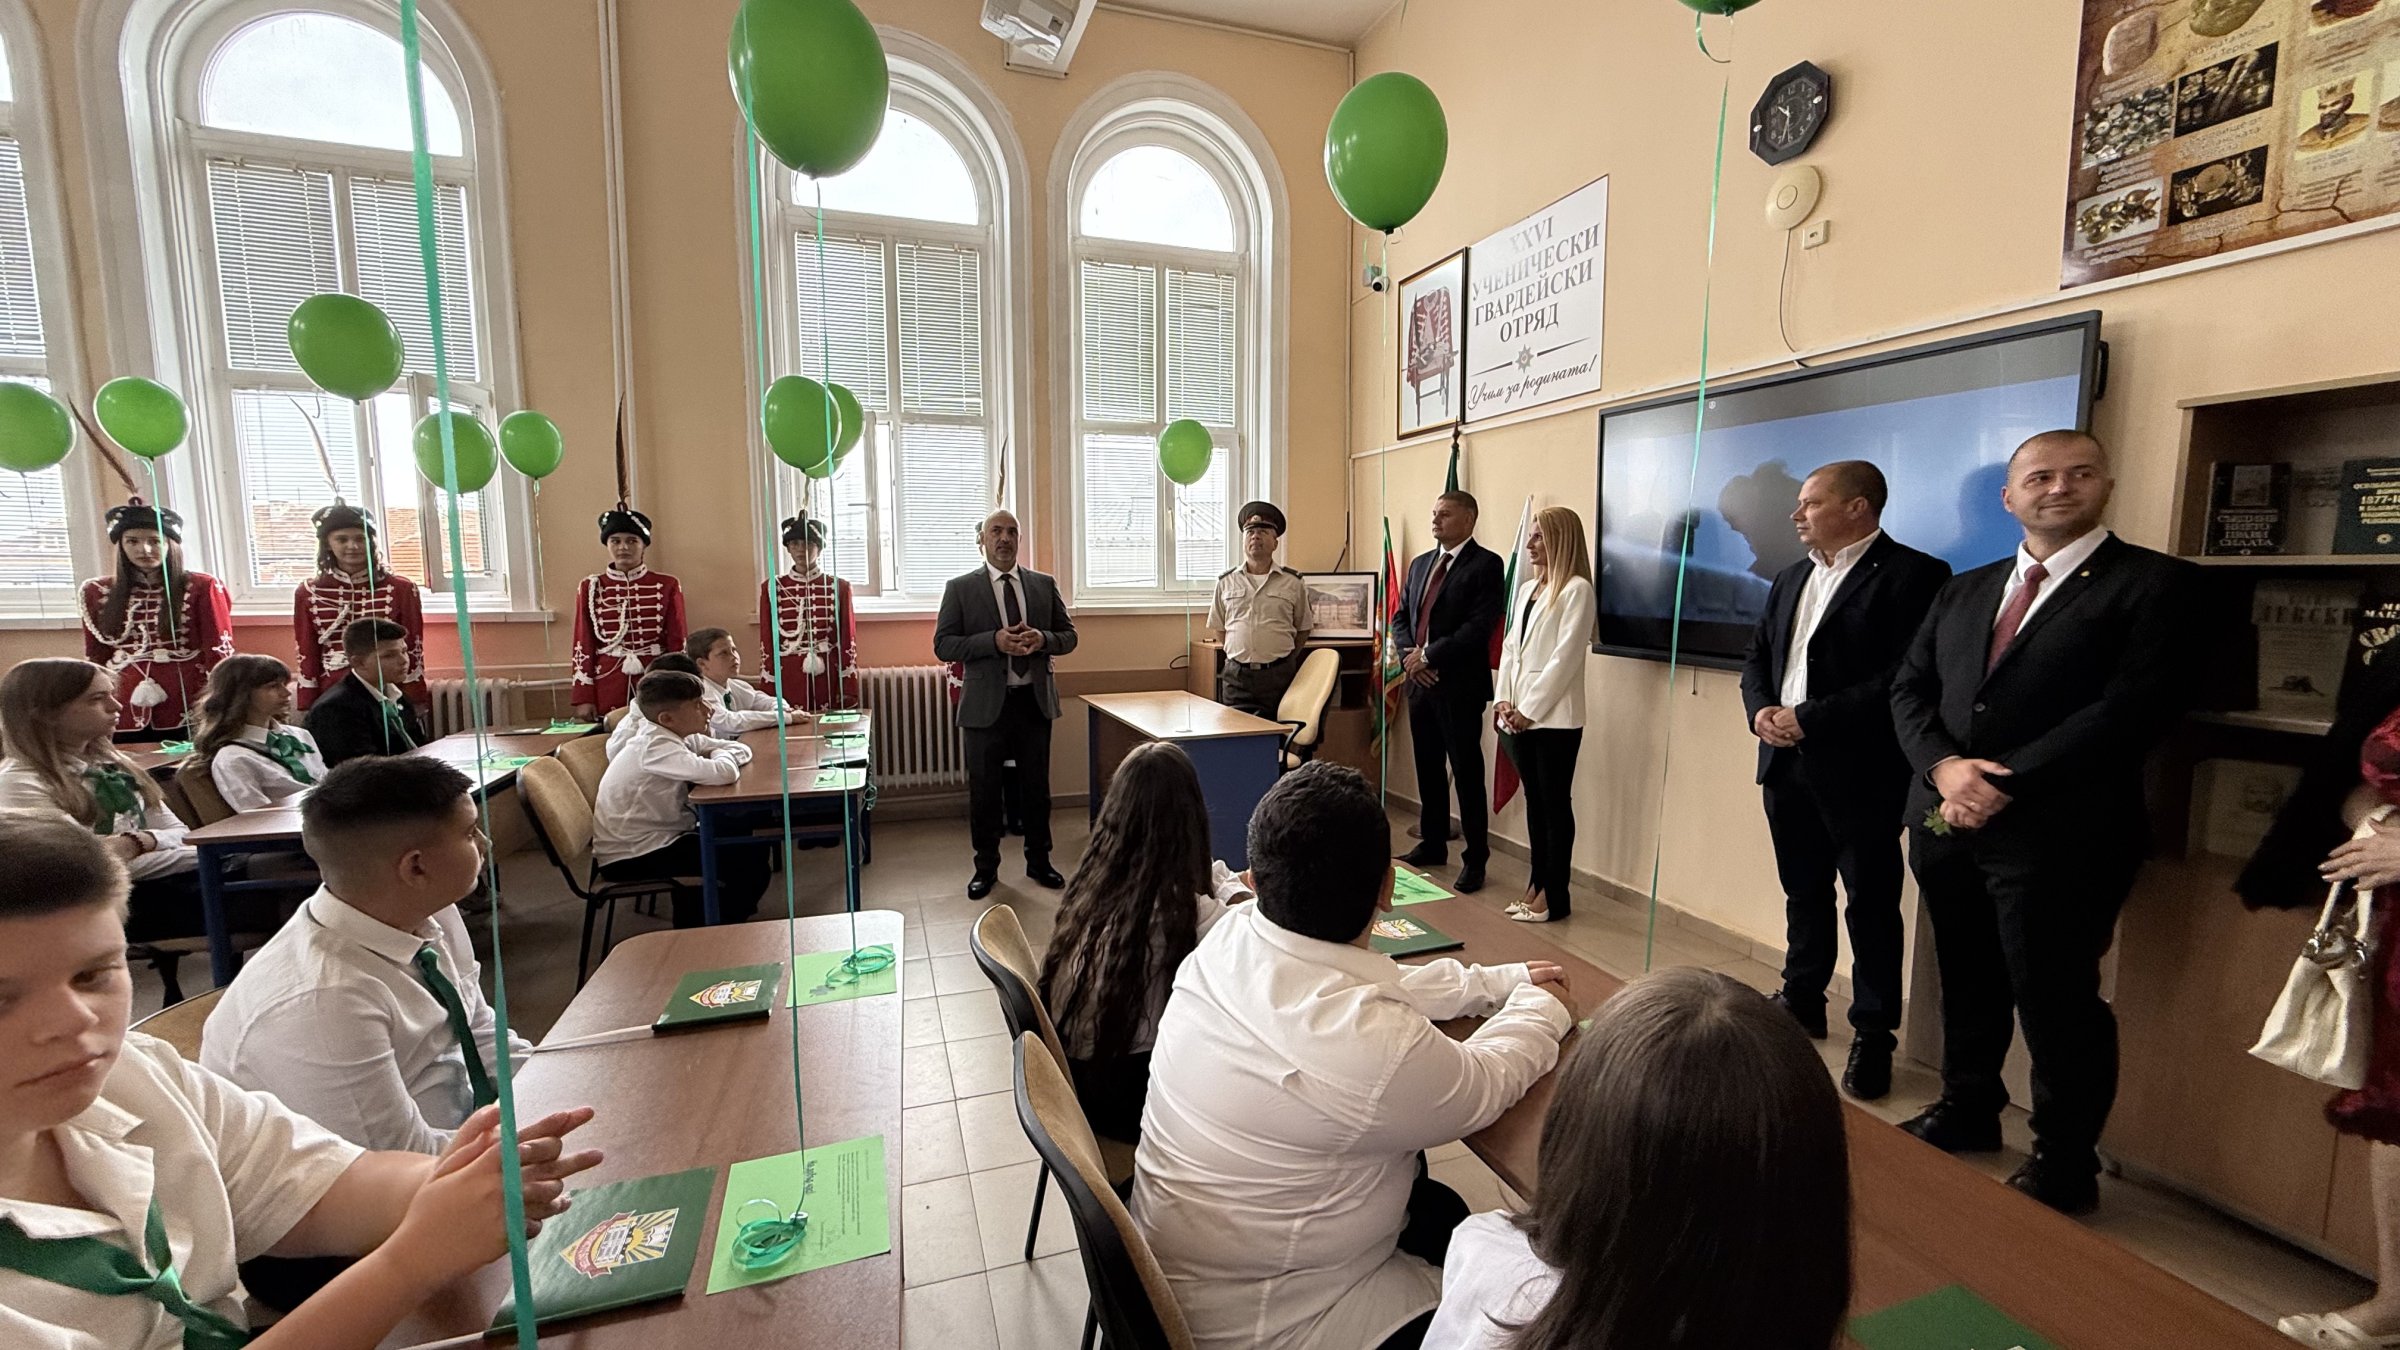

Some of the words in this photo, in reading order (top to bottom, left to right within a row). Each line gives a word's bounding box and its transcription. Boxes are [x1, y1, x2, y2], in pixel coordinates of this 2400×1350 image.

[1472, 223, 1600, 301] УЧЕНИЧЕСКИ
[1509, 215, 1554, 255] XXVI
[1475, 257, 1594, 326] ГВАРДЕЙСКИ
[1500, 302, 1559, 342] ОТРЯД
[1468, 382, 1504, 411] Учим
[1505, 383, 1521, 404] за
[1519, 354, 1598, 399] родината!
